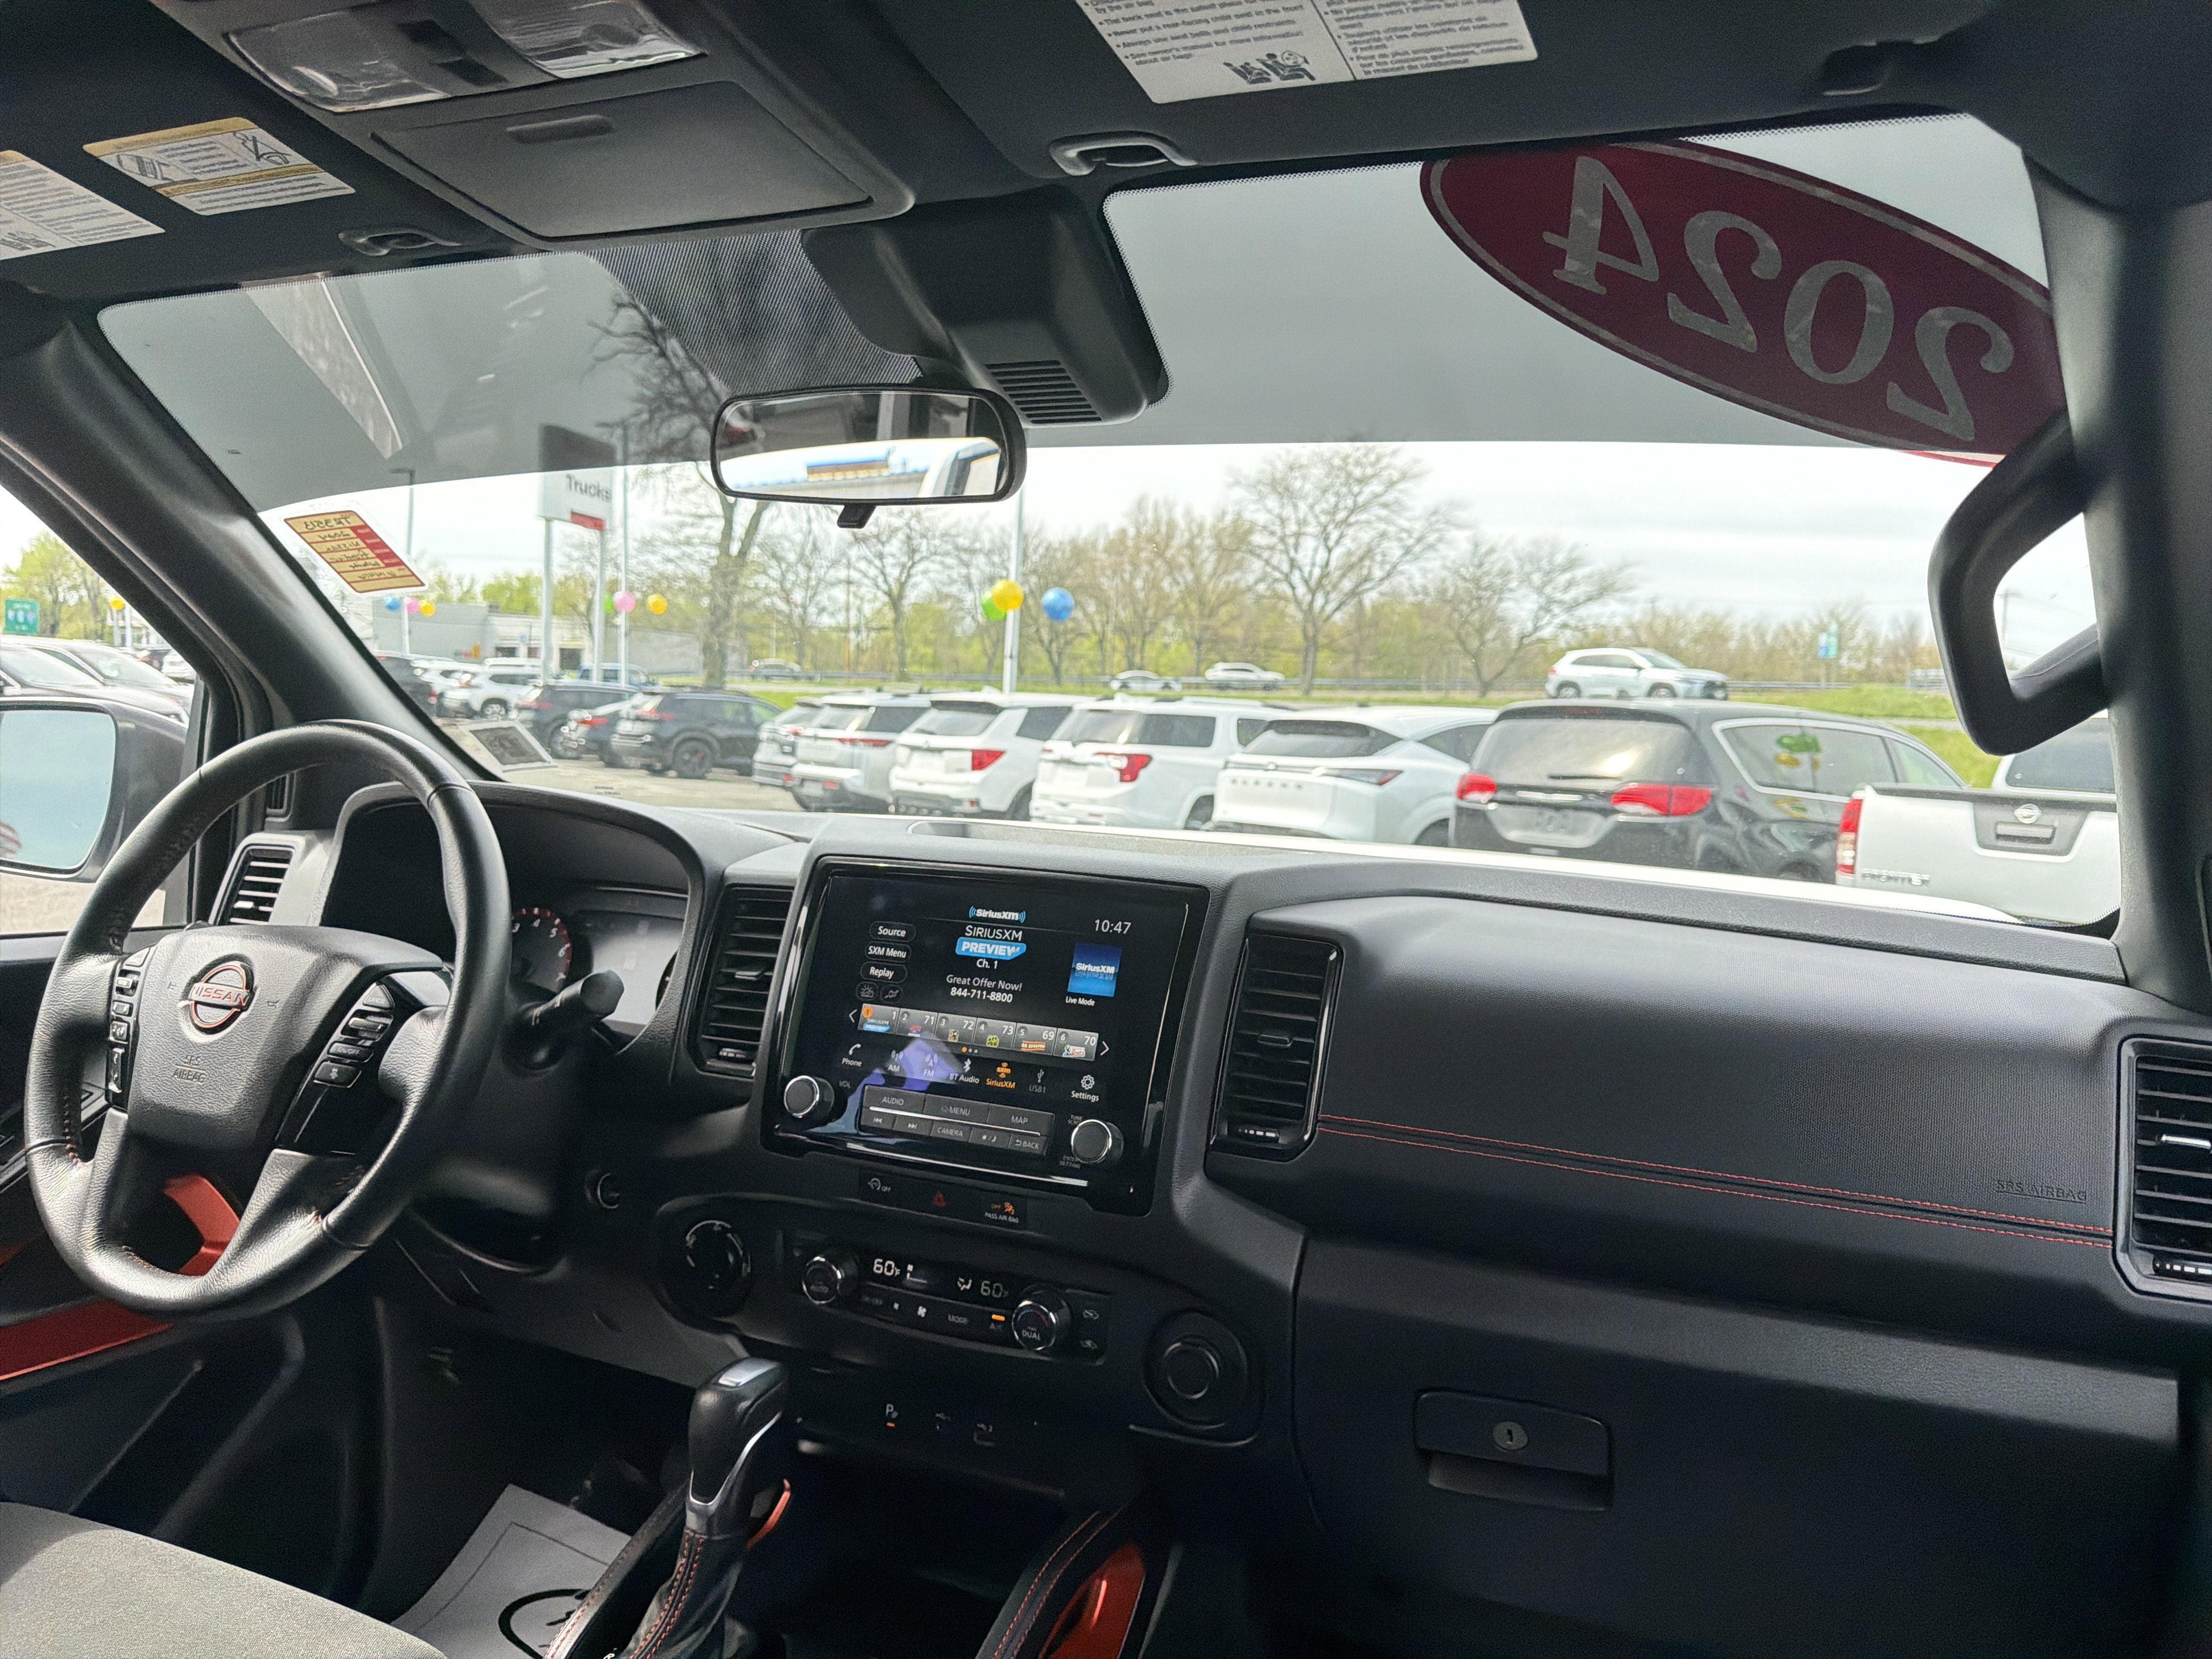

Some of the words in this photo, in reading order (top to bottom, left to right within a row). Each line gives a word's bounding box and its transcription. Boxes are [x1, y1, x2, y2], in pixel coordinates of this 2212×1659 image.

[566, 473, 611, 502] Trucks
[878, 926, 906, 937] Source
[1094, 919, 1131, 934] 10:47
[549, 928, 558, 938] 5
[965, 925, 1022, 941] SIRIUSXM
[558, 947, 566, 957] 6
[867, 945, 885, 956] SXM
[885, 947, 907, 958] Menu
[962, 941, 1021, 956] PREVIEW
[977, 958, 991, 968] Ch.
[994, 960, 998, 969] 1
[1075, 962, 1116, 974] SiriusXM
[870, 966, 894, 980] Replay
[946, 974, 970, 985] Great
[973, 977, 996, 988] Offer
[998, 980, 1022, 991] Now!
[192, 985, 249, 1007] NISSAN
[950, 986, 1013, 1003] 844-711-8800
[1065, 995, 1077, 1005] Live
[1078, 997, 1095, 1006] Mode
[924, 1015, 935, 1025] 71
[963, 1020, 974, 1030] 72
[1002, 1025, 1014, 1035] 73
[1042, 1030, 1055, 1040] 69
[1084, 1035, 1097, 1046] 70
[842, 1058, 862, 1067] Phone
[960, 1075, 980, 1084] Audio
[986, 1078, 1017, 1089] SiriusXM
[1029, 1084, 1046, 1093] USB1
[881, 1096, 904, 1105] AUDIO
[1071, 1091, 1099, 1102] Settings
[949, 1106, 970, 1116] MENU
[1011, 1115, 1028, 1124] MAP
[937, 1127, 963, 1136] CAMERA
[1022, 1141, 1040, 1150] BACK
[1996, 1180, 2024, 1192] SRS
[2032, 1184, 2087, 1201] AIRBAG
[1022, 1329, 1041, 1341] DUAL
